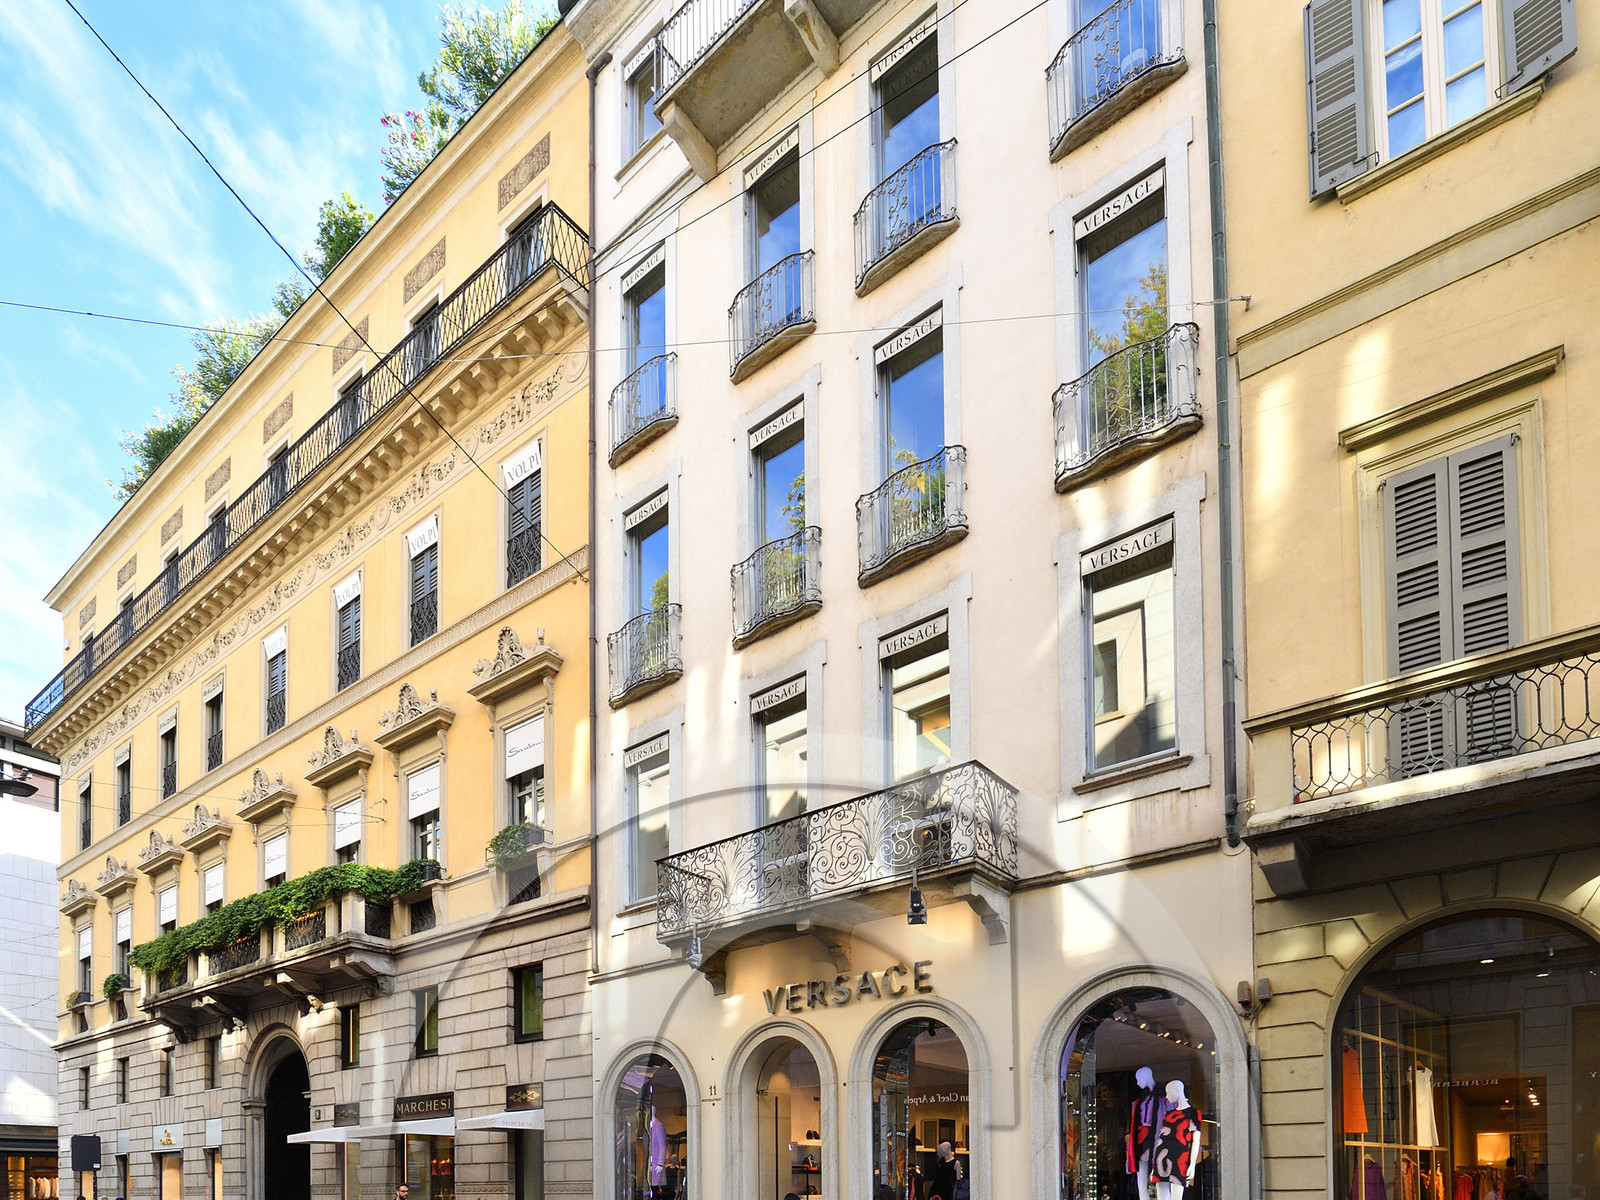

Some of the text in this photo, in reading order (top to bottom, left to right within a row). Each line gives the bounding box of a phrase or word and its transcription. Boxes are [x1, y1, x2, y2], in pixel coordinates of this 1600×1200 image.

[749, 138, 791, 180] VERSACE
[1083, 177, 1154, 232] VERSACE
[625, 250, 660, 287] VERSACE
[882, 315, 936, 358] VERSACE
[754, 407, 798, 443] VERSACE
[508, 453, 539, 481] VOLPI
[629, 495, 664, 526] VERSACE
[411, 526, 437, 551] VOLPI
[1090, 528, 1162, 569] VERSACE
[337, 581, 360, 602] VOLPI
[886, 620, 940, 654] VERSACE
[756, 681, 800, 710] VERSACE
[507, 738, 544, 758] Santoni
[628, 740, 664, 764] VERSACE
[762, 959, 934, 1016] VERSACE
[709, 1084, 717, 1096] 11
[396, 1098, 451, 1115] MARCHESI
